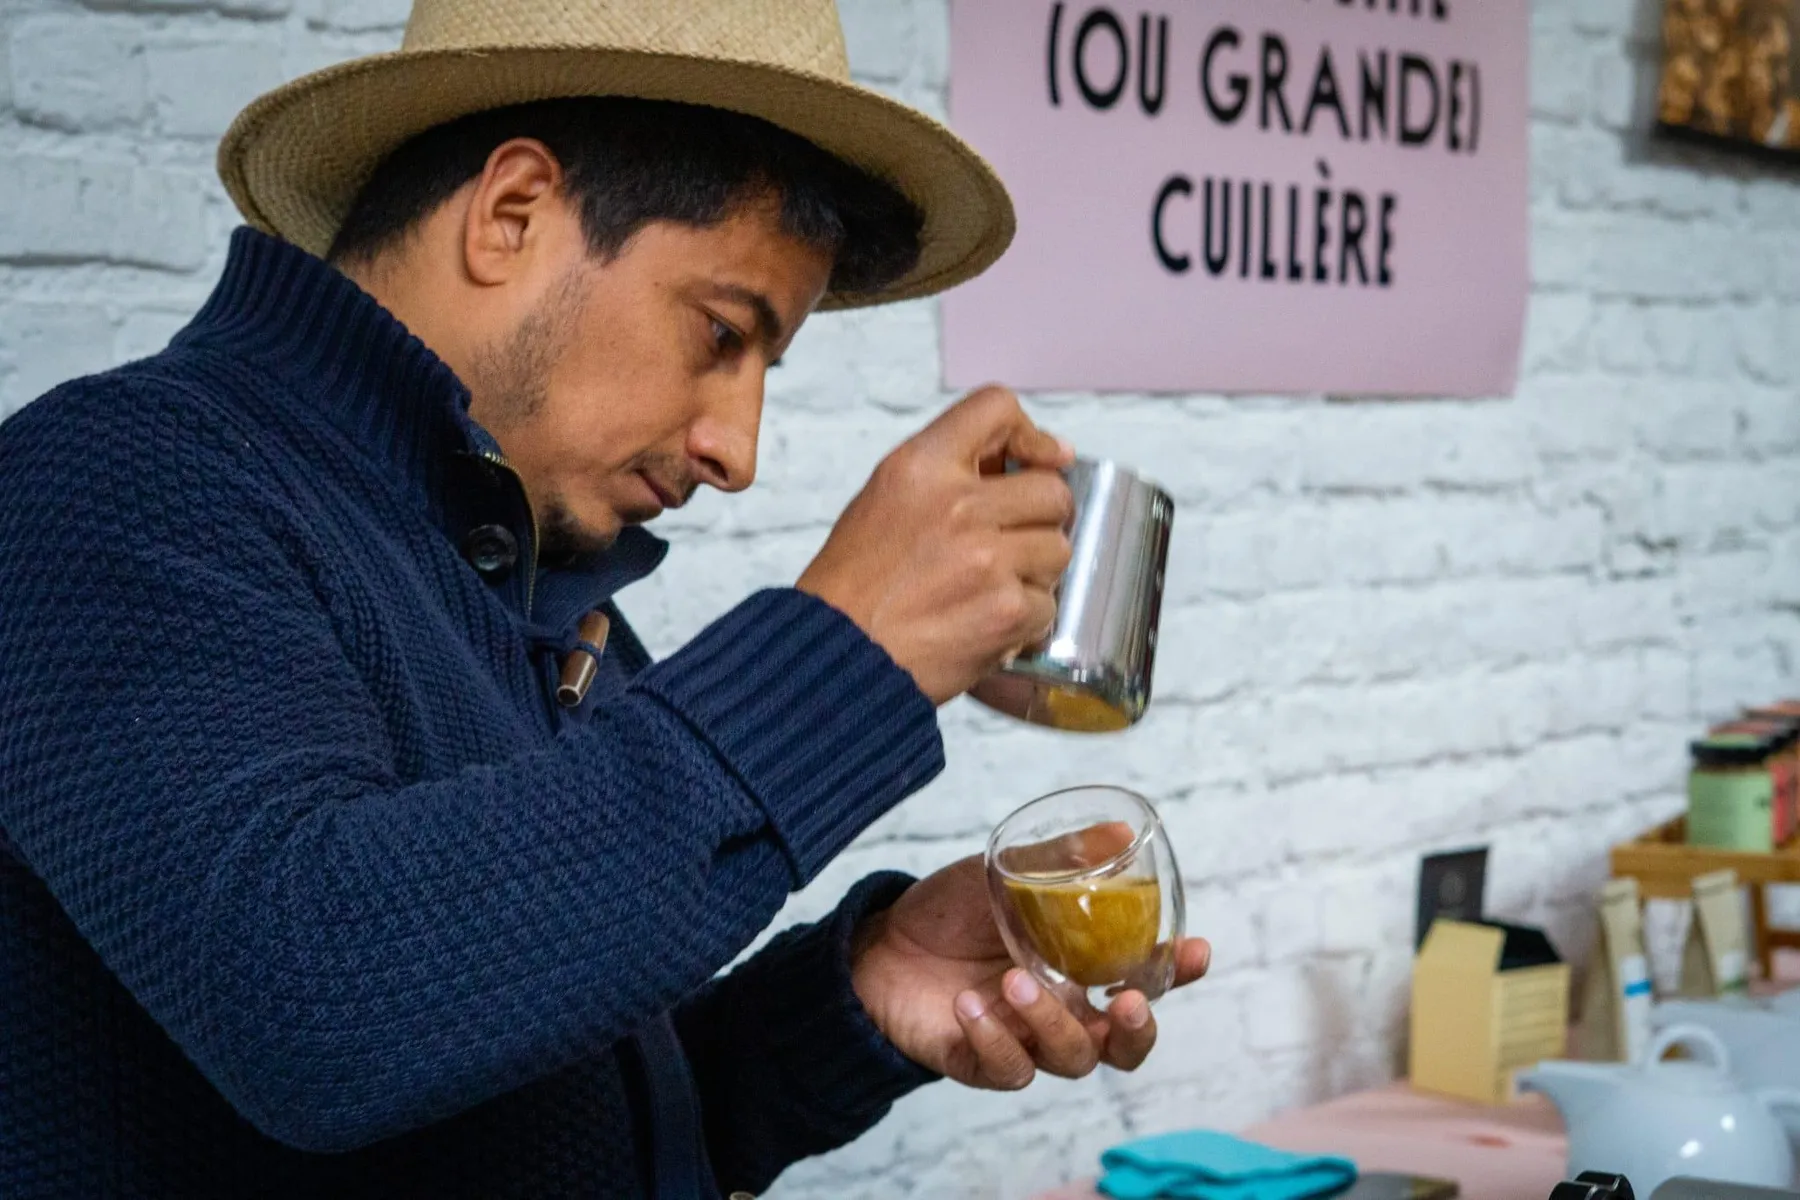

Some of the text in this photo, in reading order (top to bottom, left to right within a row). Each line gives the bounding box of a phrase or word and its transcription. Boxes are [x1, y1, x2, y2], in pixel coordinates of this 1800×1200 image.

[1045, 1, 1482, 154] (OU GRANDE)
[1150, 159, 1397, 288] CUILLÈRE
